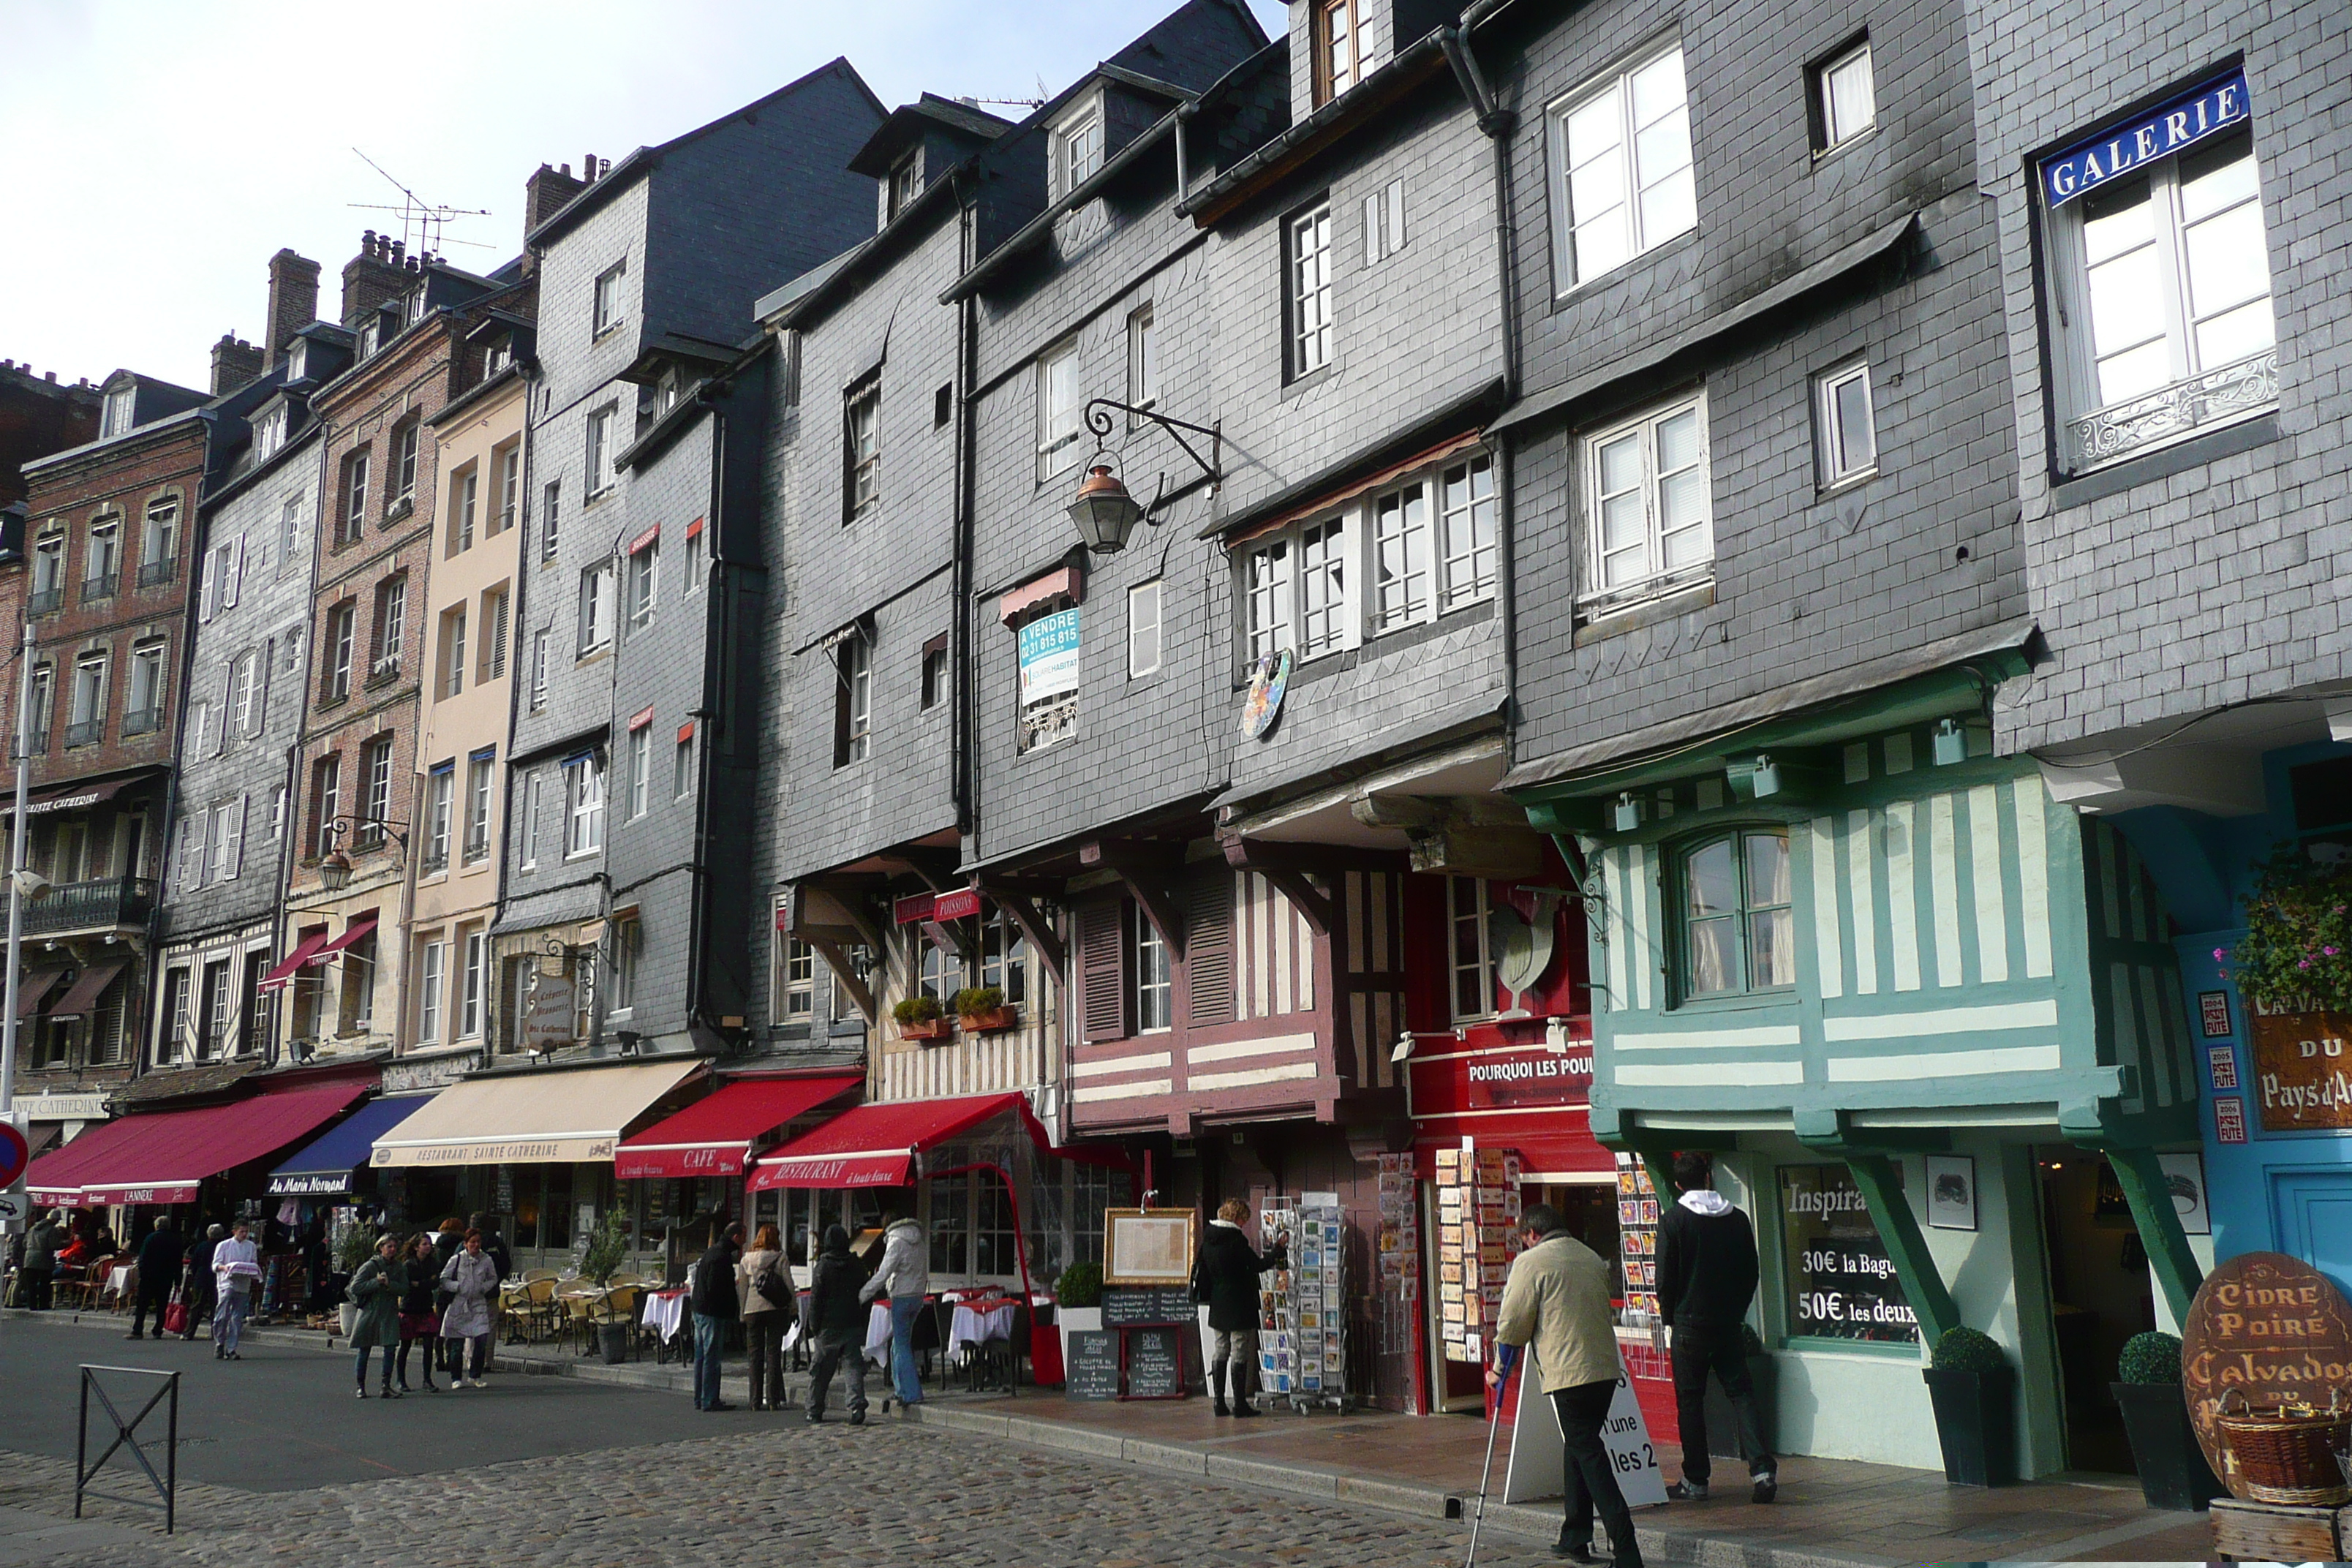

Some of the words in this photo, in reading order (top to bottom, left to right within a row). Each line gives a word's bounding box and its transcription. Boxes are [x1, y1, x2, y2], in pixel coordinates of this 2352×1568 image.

[2052, 83, 2240, 196] GALERIE
[1021, 631, 1028, 646] A
[1029, 612, 1075, 639] VENDRE
[1022, 645, 1030, 659] 02
[1030, 640, 1039, 655] 31
[1040, 633, 1056, 650] 815
[1058, 627, 1077, 644] 815
[53, 793, 99, 810] CATHERINE
[939, 894, 972, 916] POISSONS
[537, 1003, 569, 1017] Brasserie
[2204, 999, 2223, 1009] 2004
[2213, 1053, 2231, 1061] 2005
[2299, 1038, 2342, 1058] DU
[1469, 1061, 1534, 1082] POURQUOI
[1537, 1060, 1558, 1077] LES
[1561, 1057, 1593, 1075] POUL
[2261, 1072, 2319, 1120] Pays
[2321, 1070, 2352, 1112] d'A
[15, 1101, 35, 1114] INTE
[38, 1098, 102, 1114] CATHERINE
[1416, 1122, 1424, 1130] 16
[416, 1148, 469, 1161] RESTAURANT
[474, 1146, 505, 1159] SAINTE
[507, 1144, 559, 1158] CATHERINE
[774, 1161, 848, 1180] RESTAURANT
[268, 1177, 282, 1193] Au
[282, 1177, 308, 1193] Marin
[309, 1174, 347, 1194] Normand
[124, 1189, 154, 1202] L'ANNEXE
[1789, 1180, 1867, 1221] Inspira
[1802, 1251, 1837, 1273] 30€
[1843, 1254, 1857, 1273] la
[1858, 1254, 1897, 1279] Bagu
[1798, 1292, 1844, 1321] 50€
[1849, 1303, 1870, 1322] les
[1874, 1297, 1918, 1324] deux
[2266, 1391, 2299, 1401] DU
[1610, 1448, 1642, 1473] les
[1643, 1443, 1657, 1469] 2
